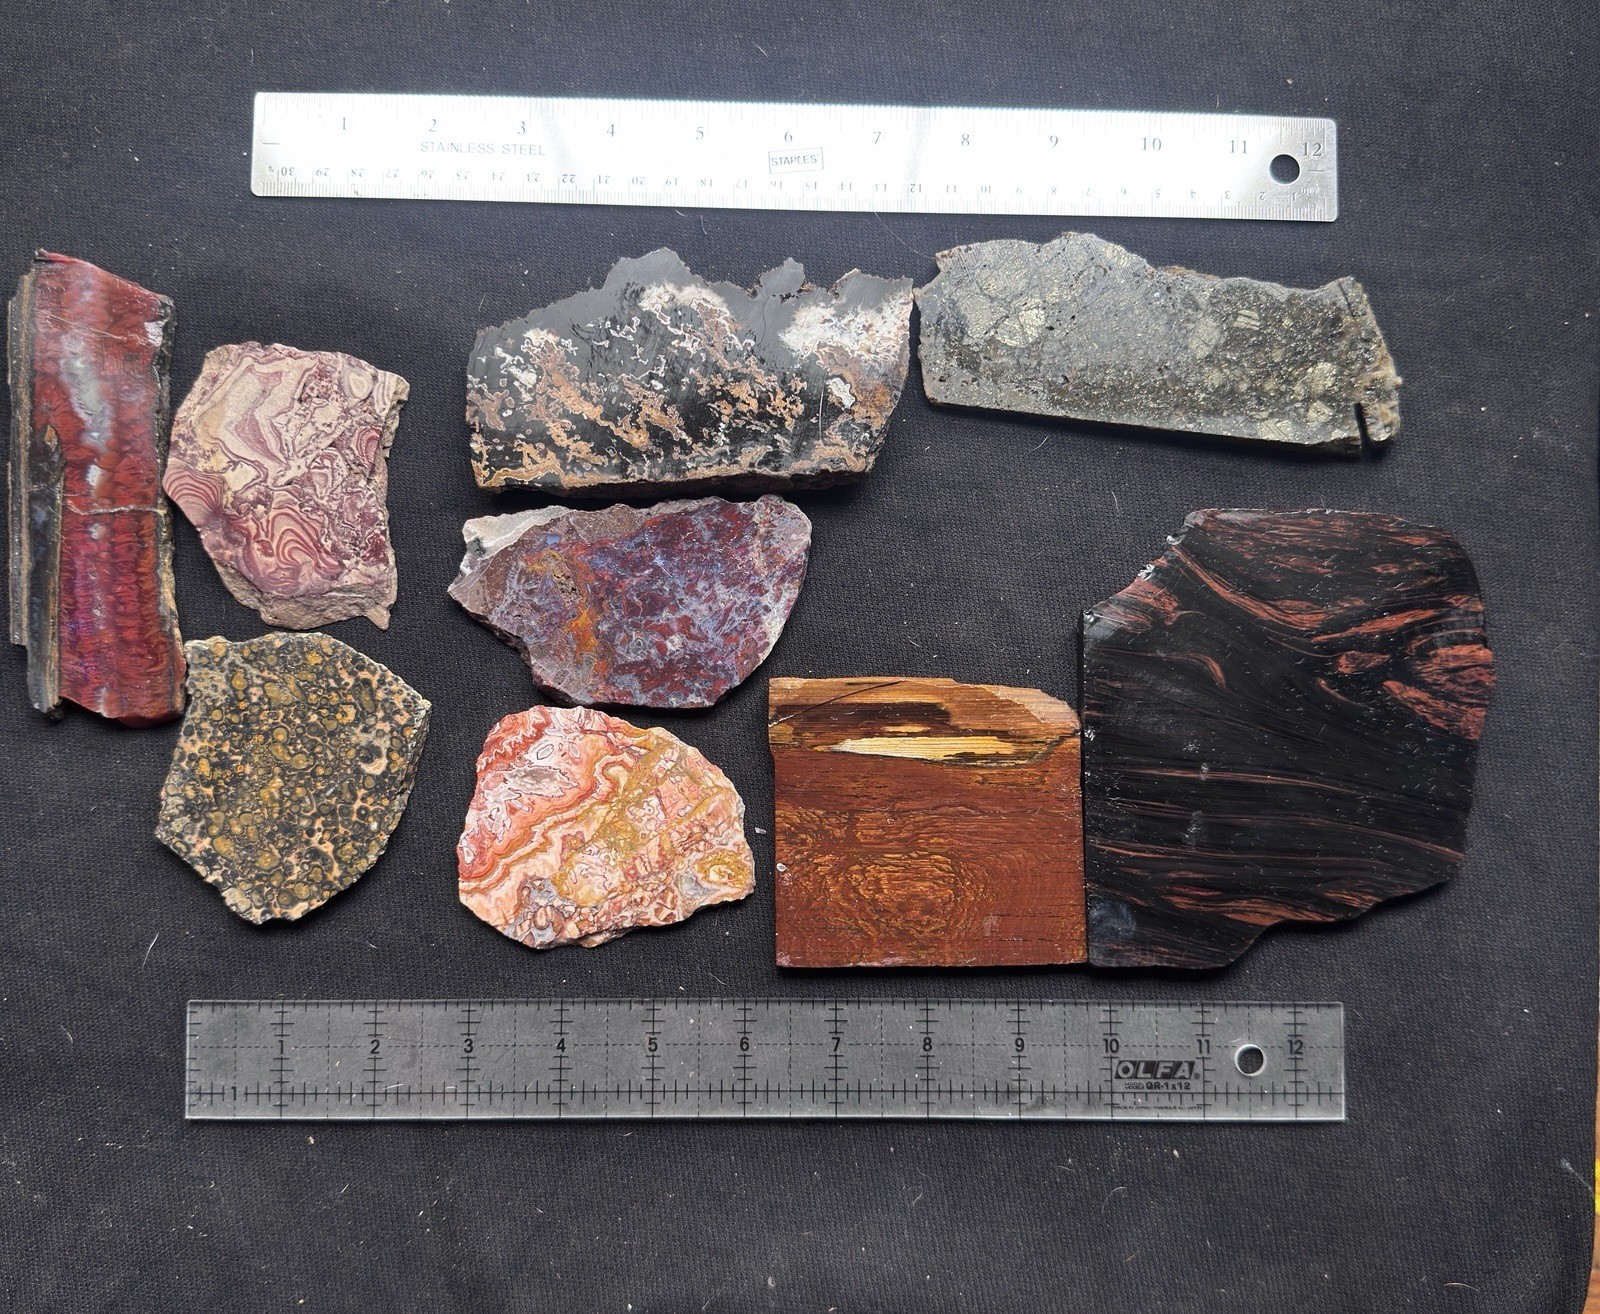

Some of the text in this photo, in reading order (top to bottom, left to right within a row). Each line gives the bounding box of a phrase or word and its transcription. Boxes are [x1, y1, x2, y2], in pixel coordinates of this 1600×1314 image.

[341, 117, 1323, 157] 1 2 3 4 5 6 7 8 9 10 11 12
[420, 141, 546, 156] STAINLESS STEEL
[770, 153, 818, 167] STAPLES
[280, 166, 296, 177] 30
[315, 167, 330, 177] 29
[350, 168, 365, 177] 28
[386, 168, 400, 178] 27
[527, 171, 541, 182] 23
[562, 173, 576, 184] 22
[598, 175, 611, 184] 21
[631, 176, 645, 186] 20
[665, 177, 678, 187] 19
[700, 178, 713, 188] 18
[735, 179, 748, 189] 17
[770, 181, 783, 190] 16
[840, 182, 852, 191] 14
[875, 183, 887, 192] 13
[910, 183, 922, 193] 12
[945, 184, 957, 193] 11
[980, 185, 992, 194] 10
[277, 1036, 1304, 1055] 1 2 3 4 5 6 7 8 9 10 11 12
[230, 1086, 238, 1101] 1
